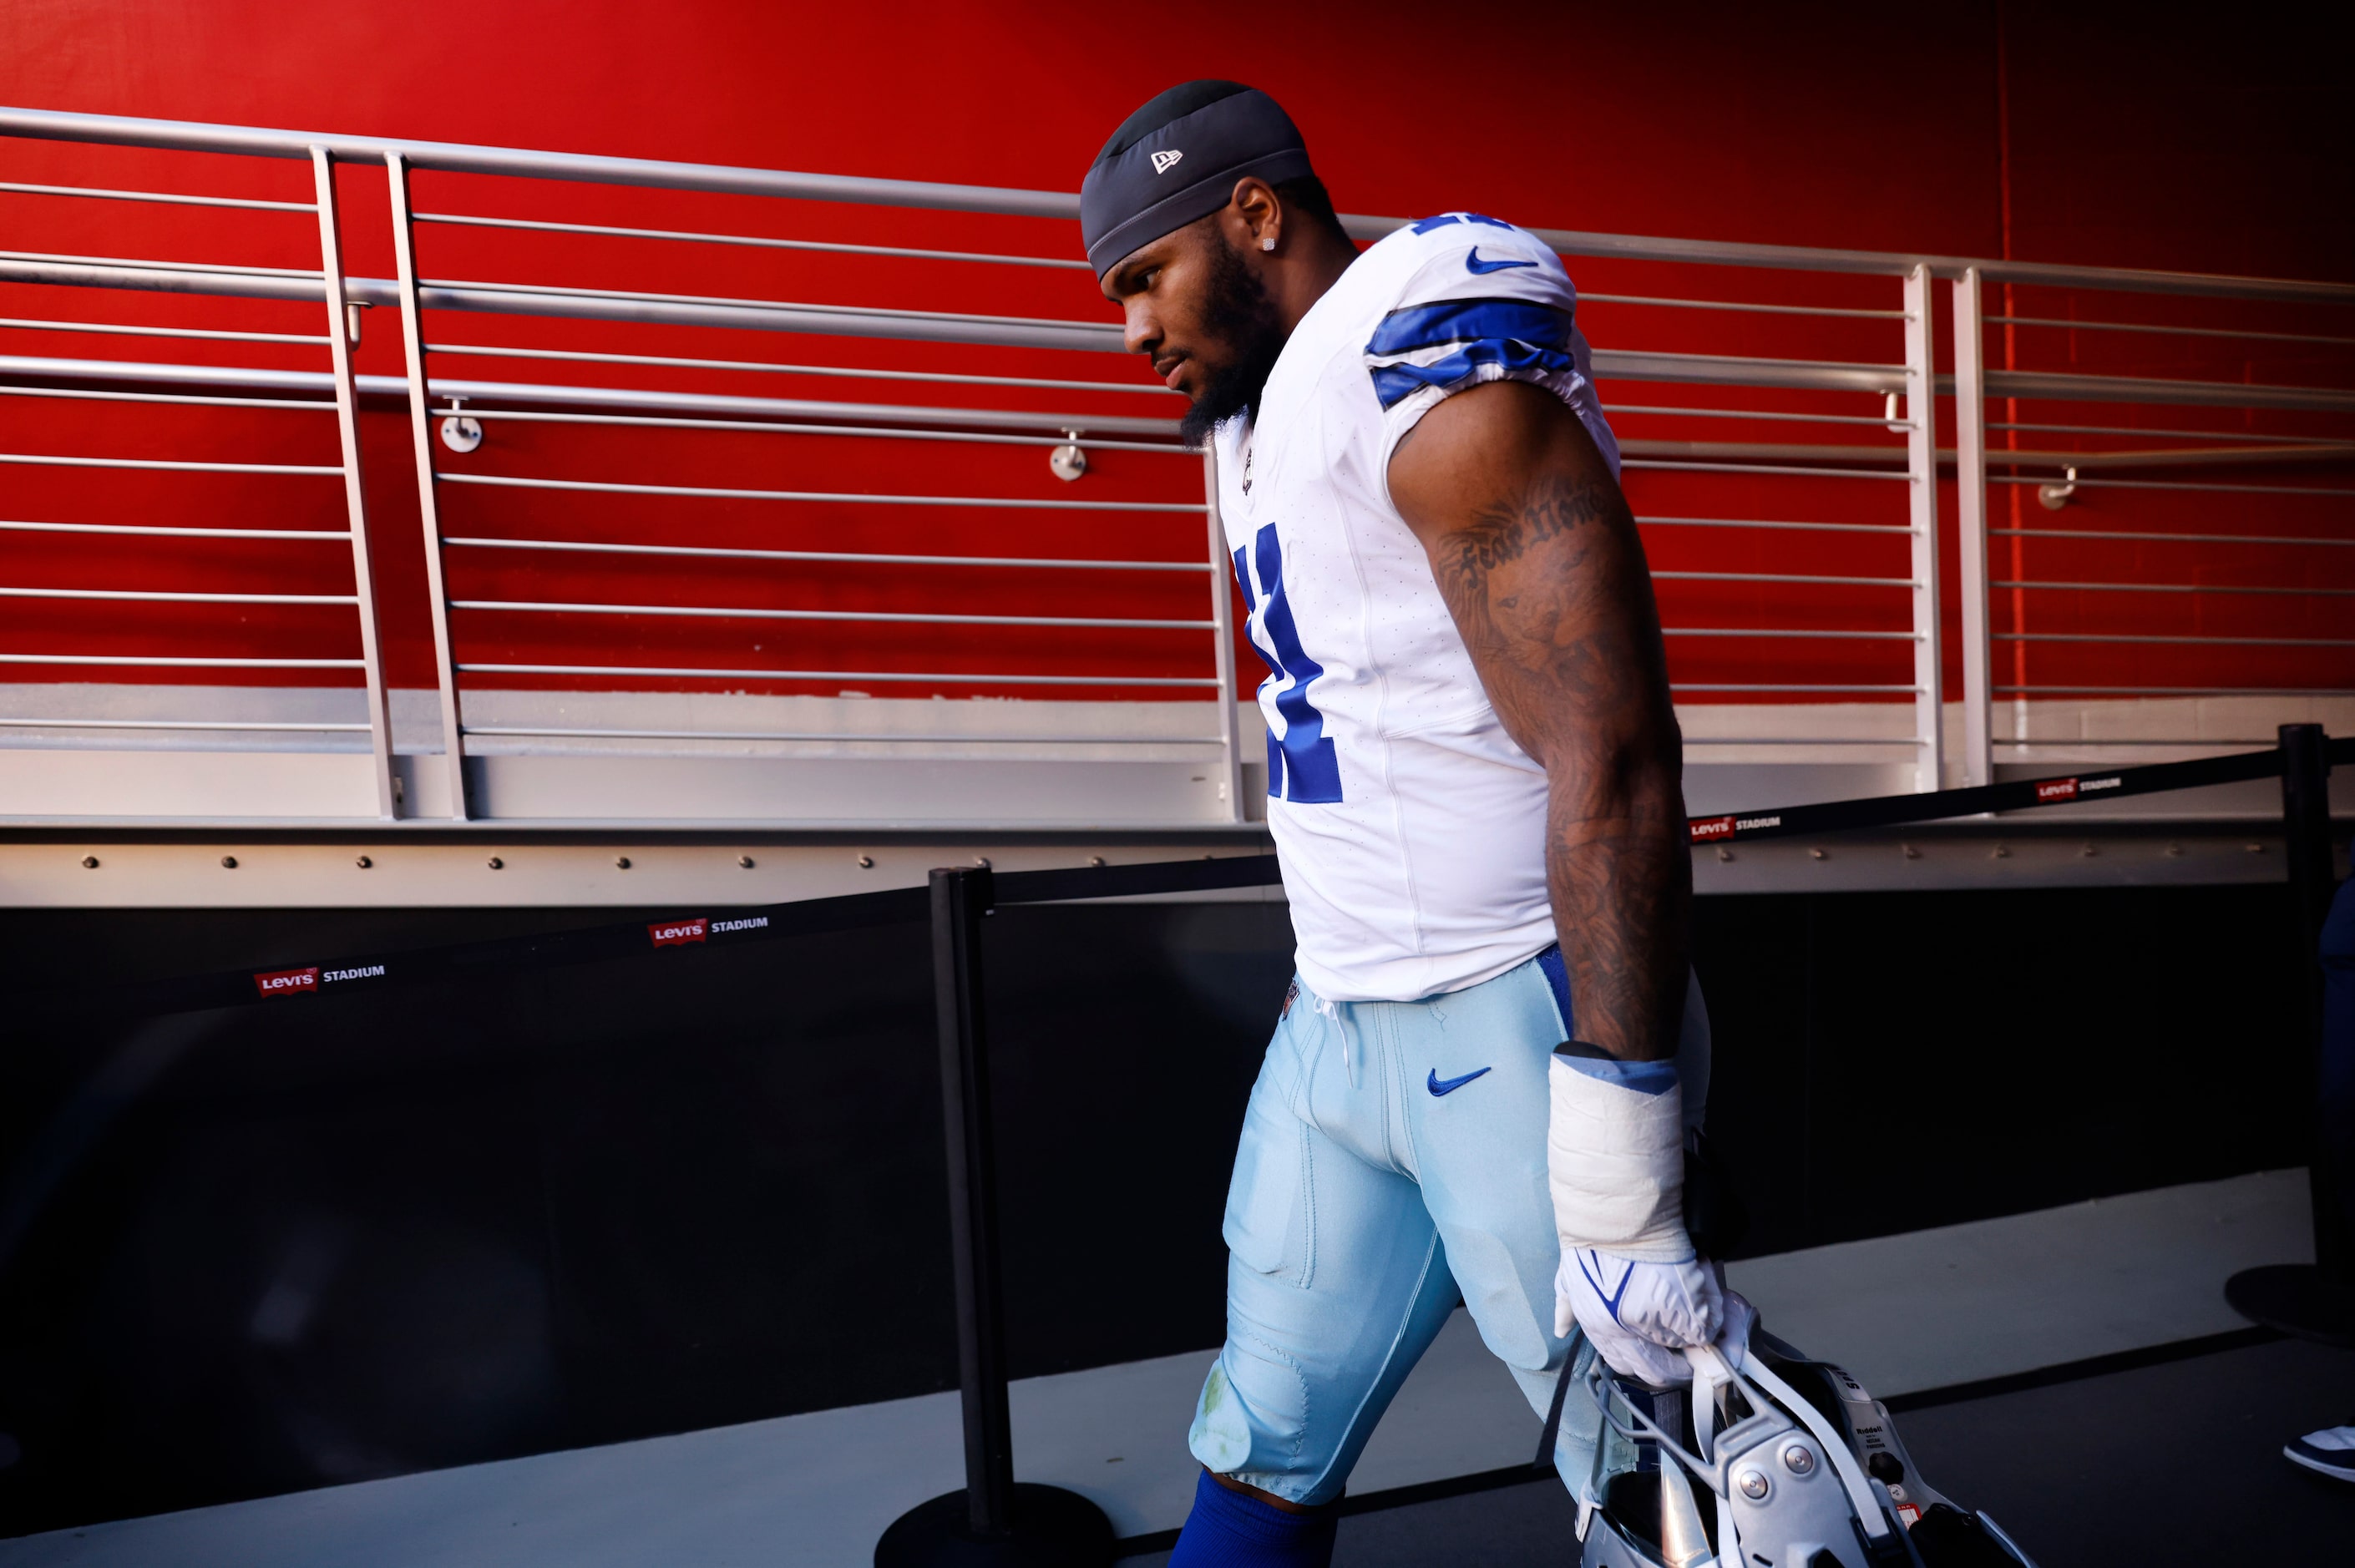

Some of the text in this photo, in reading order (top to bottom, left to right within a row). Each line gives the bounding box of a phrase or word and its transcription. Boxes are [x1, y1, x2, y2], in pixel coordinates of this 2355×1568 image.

[1735, 816, 1781, 831] STADIUM
[712, 917, 768, 933] STADIUM
[323, 965, 385, 983] STADIUM
